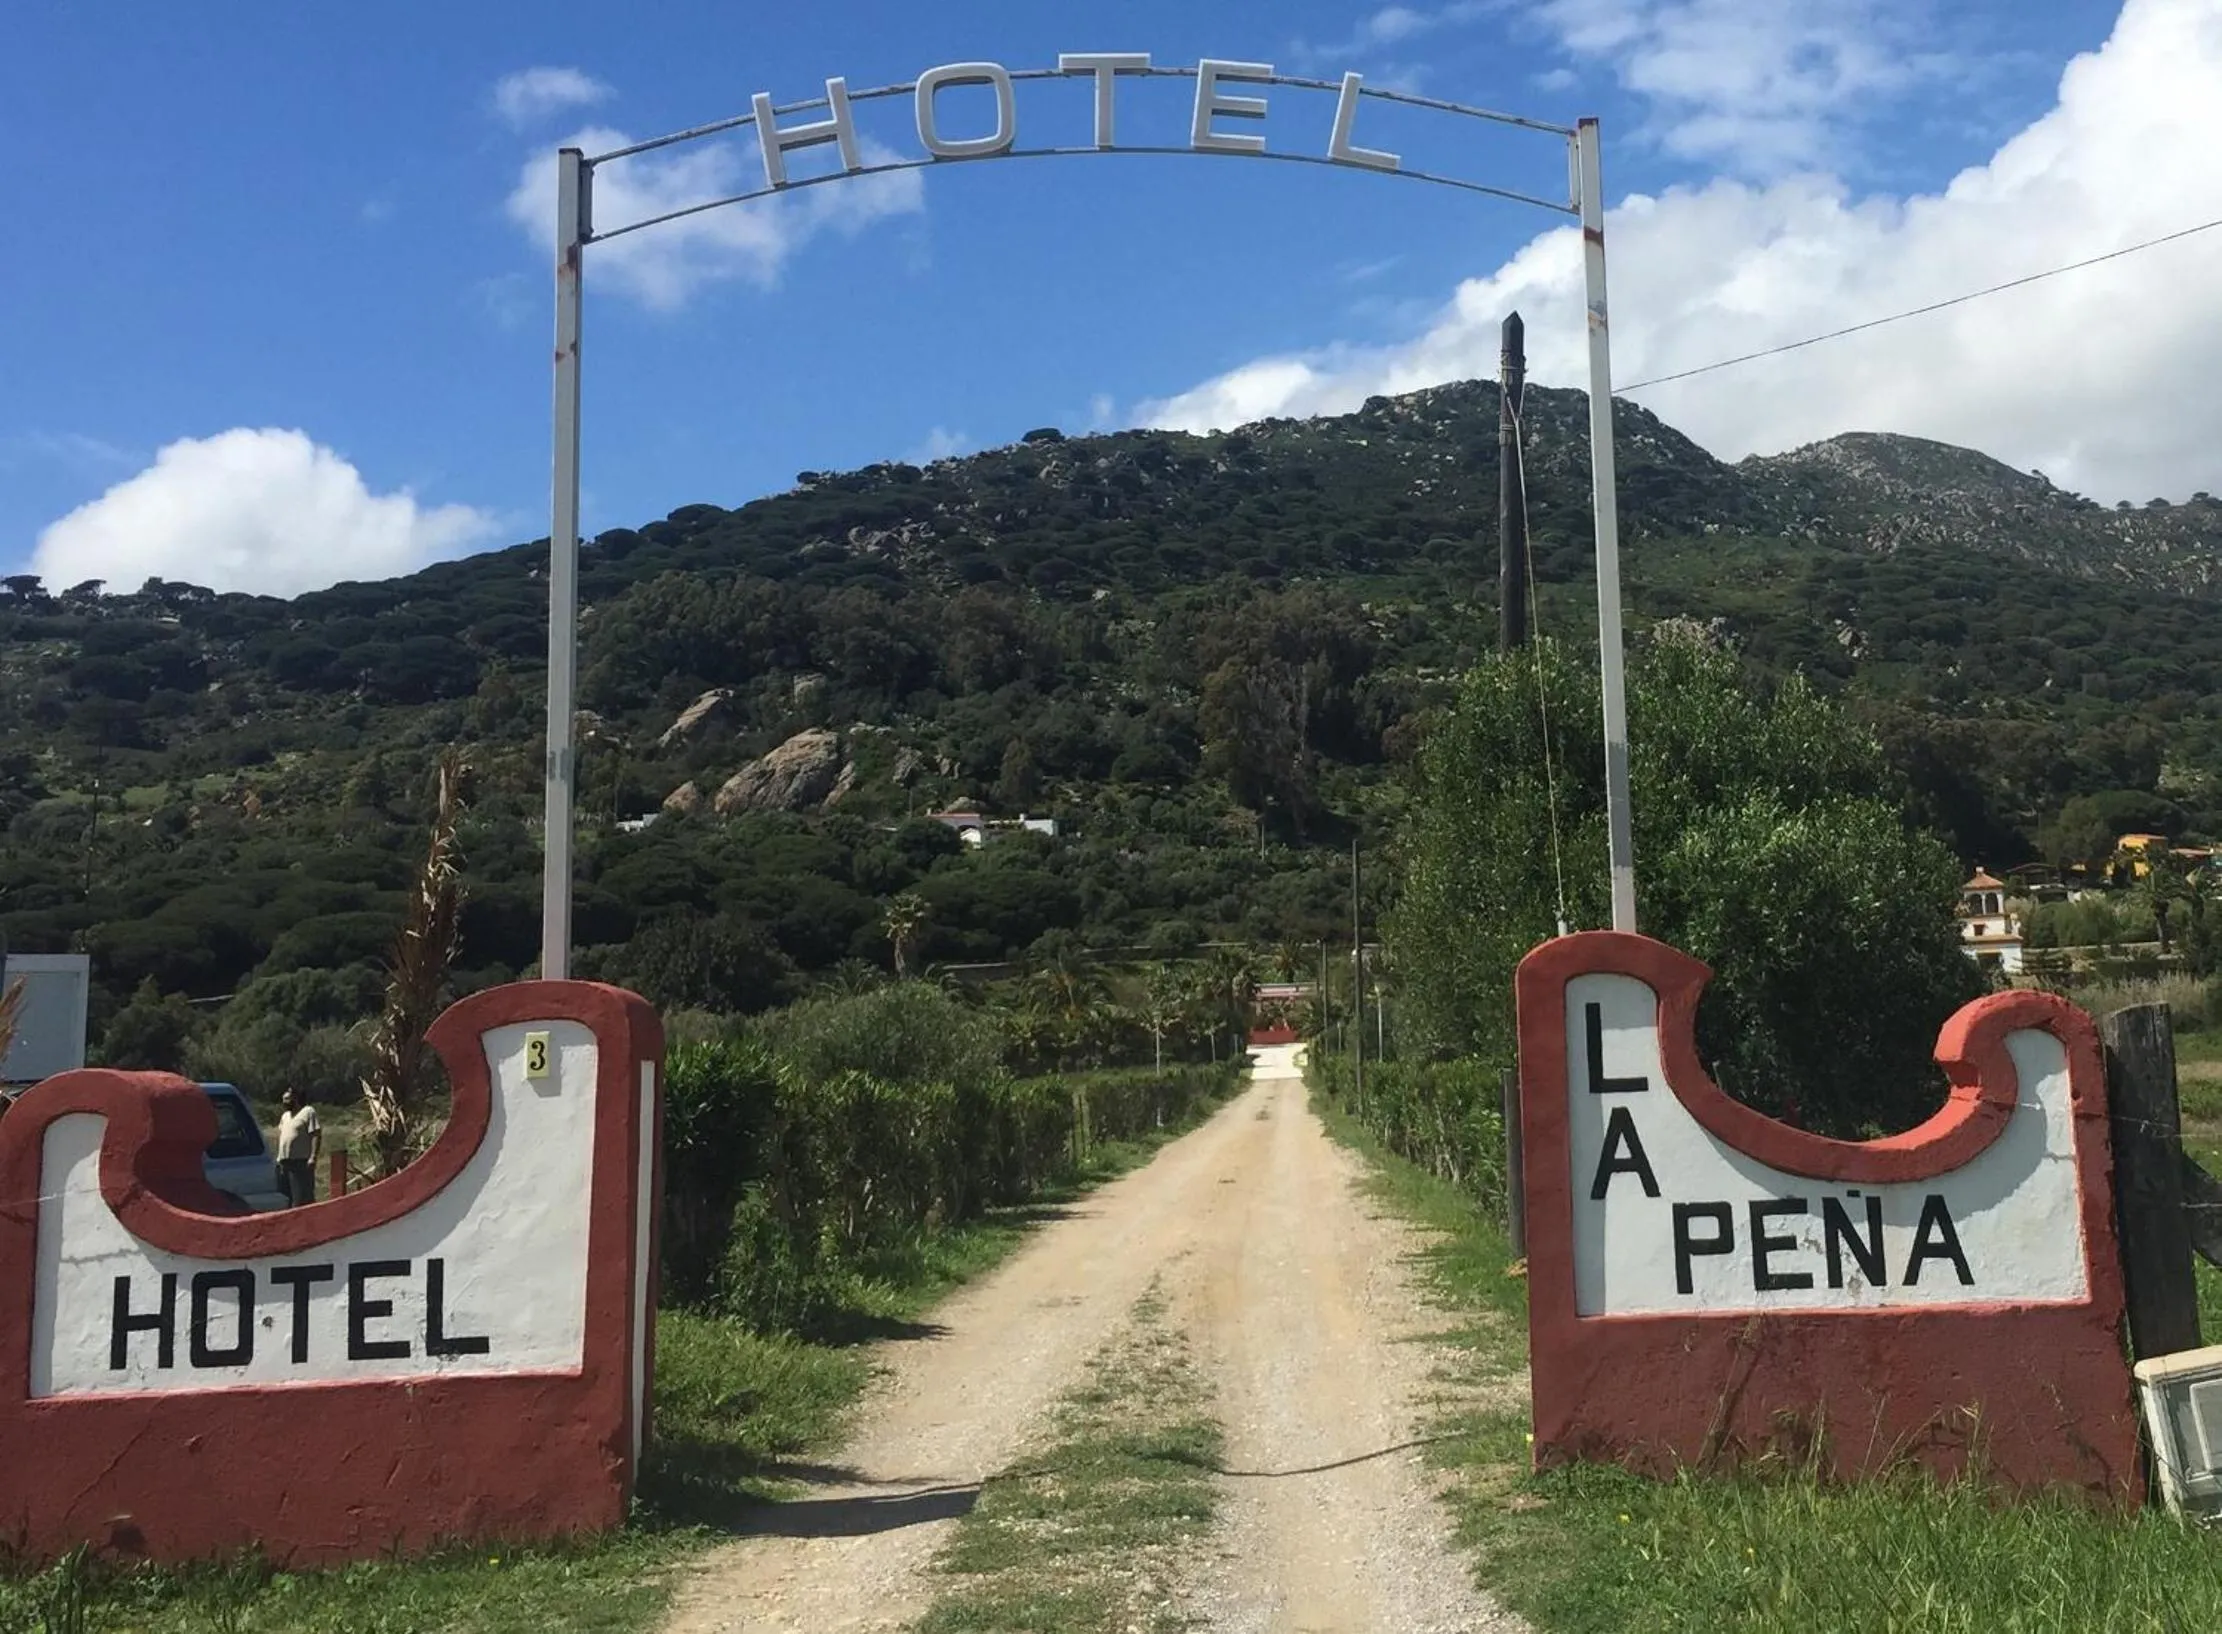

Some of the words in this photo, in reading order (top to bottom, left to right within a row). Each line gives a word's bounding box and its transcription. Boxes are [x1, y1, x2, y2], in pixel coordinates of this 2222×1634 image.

[751, 52, 1402, 187] HOTEL
[527, 1040, 546, 1071] 3
[1584, 1002, 1661, 1200] LA
[1672, 1189, 1975, 1295] PEÑA
[110, 1257, 490, 1371] HOTEL
